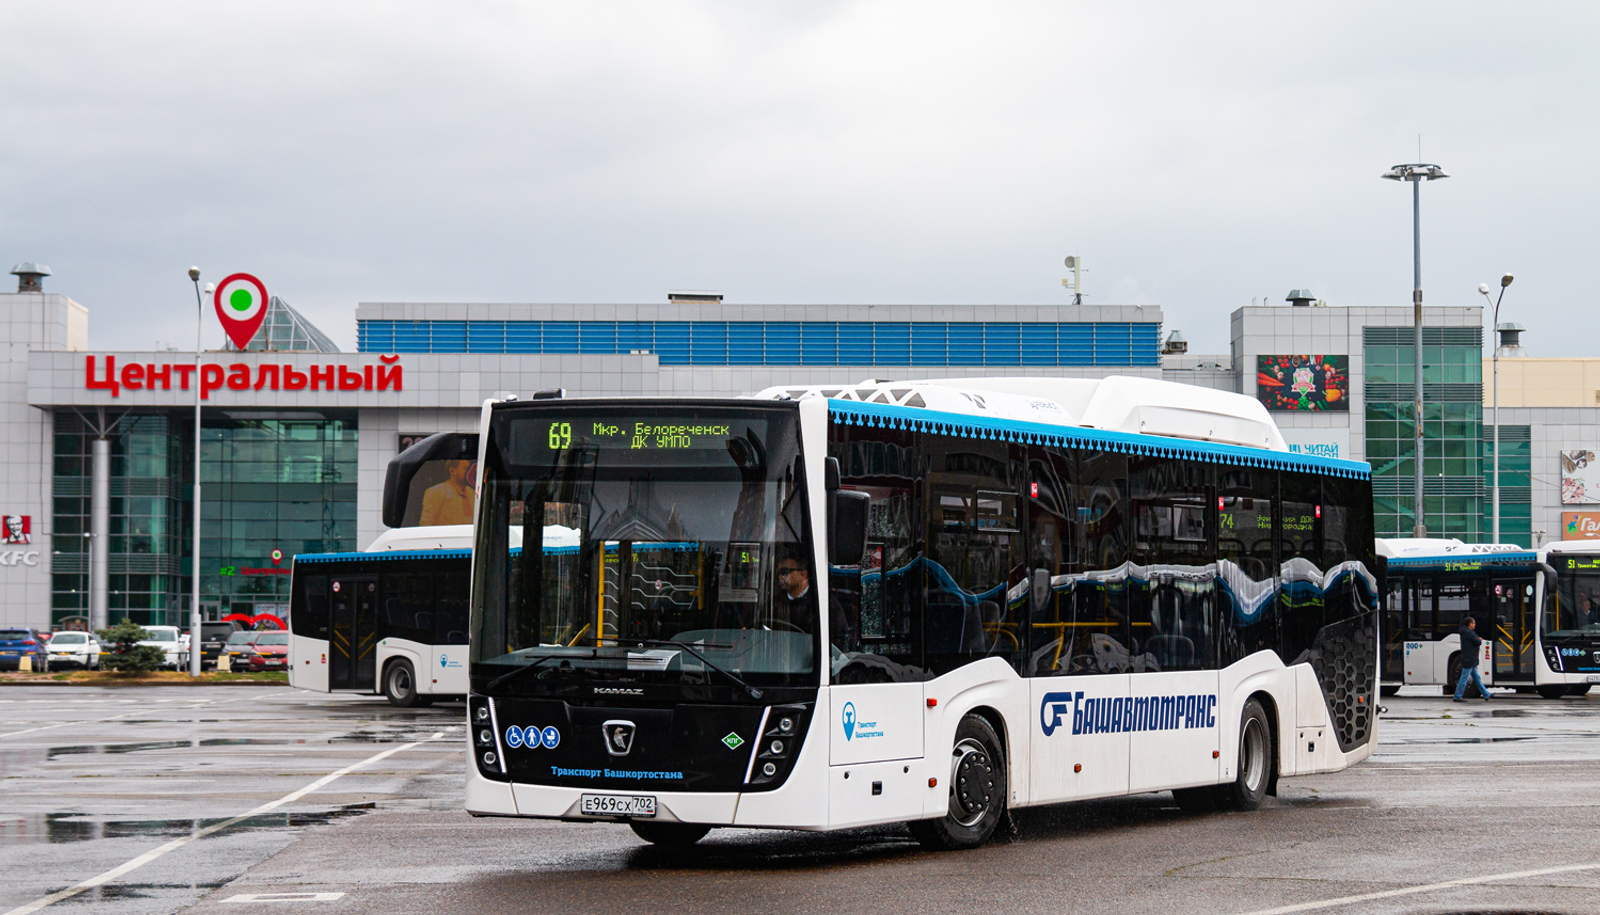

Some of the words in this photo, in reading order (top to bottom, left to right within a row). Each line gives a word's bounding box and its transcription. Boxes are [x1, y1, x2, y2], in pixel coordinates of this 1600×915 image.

[85, 354, 403, 399] Центральный
[549, 422, 572, 449] 69
[593, 422, 626, 436] Мкр.
[635, 422, 730, 436] Белореченск
[631, 435, 648, 449] ДК
[656, 435, 691, 448] УМПО
[1304, 442, 1339, 453] ЧИТАЙ
[1220, 513, 1234, 529] 74
[0, 551, 40, 566] KFC
[1567, 559, 1576, 569] 51
[219, 566, 235, 576] #2
[594, 687, 644, 695] KAMAZ
[551, 766, 602, 779] Транспорт
[604, 768, 684, 780] Башкортостана
[585, 797, 632, 811] Е969СХ
[634, 798, 652, 808] 702
